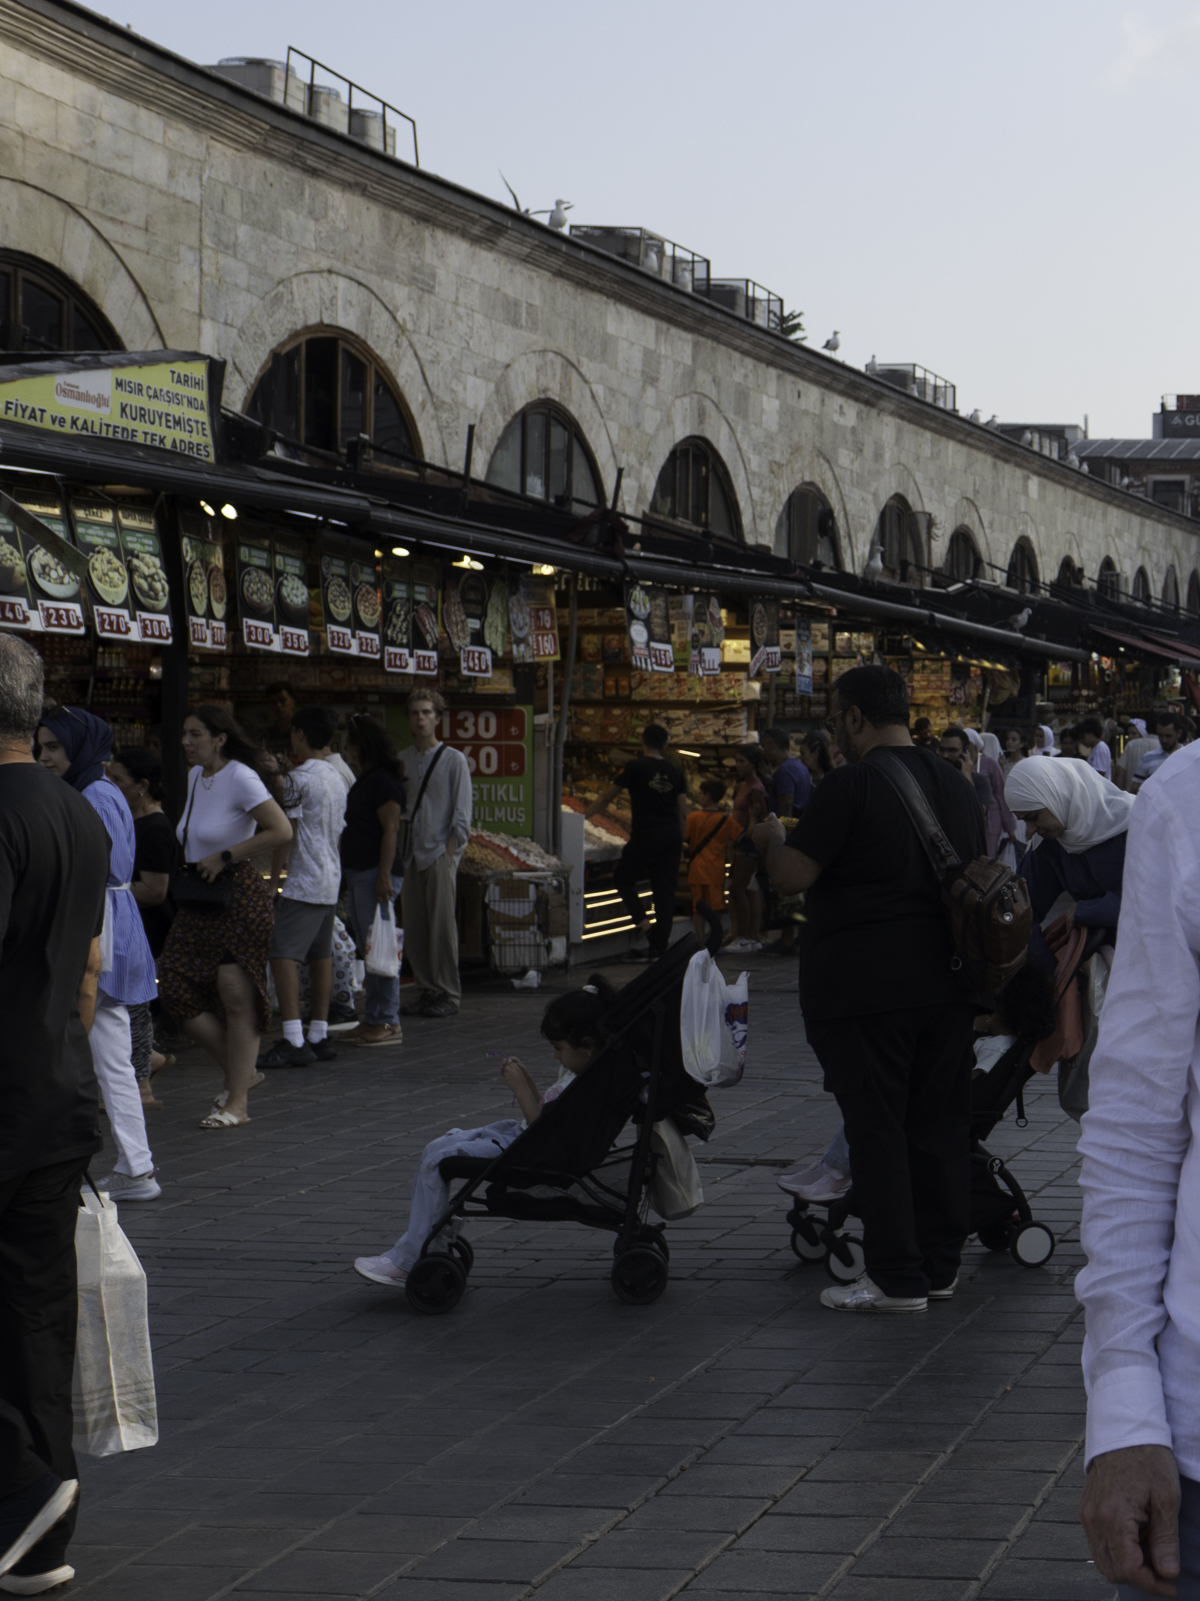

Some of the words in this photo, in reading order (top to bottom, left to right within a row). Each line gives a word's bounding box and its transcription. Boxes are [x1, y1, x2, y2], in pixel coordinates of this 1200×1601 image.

[115, 376, 144, 397] MISIR
[169, 369, 204, 391] TARİHİ
[4, 398, 46, 423] FİYAT
[50, 413, 66, 428] ve
[70, 415, 138, 440] KALİTEDE
[142, 430, 167, 447] TEK
[170, 437, 210, 458] ADRES
[120, 401, 209, 438] KURUYEMİŞTE
[48, 609, 77, 627] 230
[102, 613, 126, 632] 270
[145, 620, 167, 637] 300
[250, 627, 270, 644] 300
[286, 633, 305, 650] 350
[442, 710, 497, 739] 130
